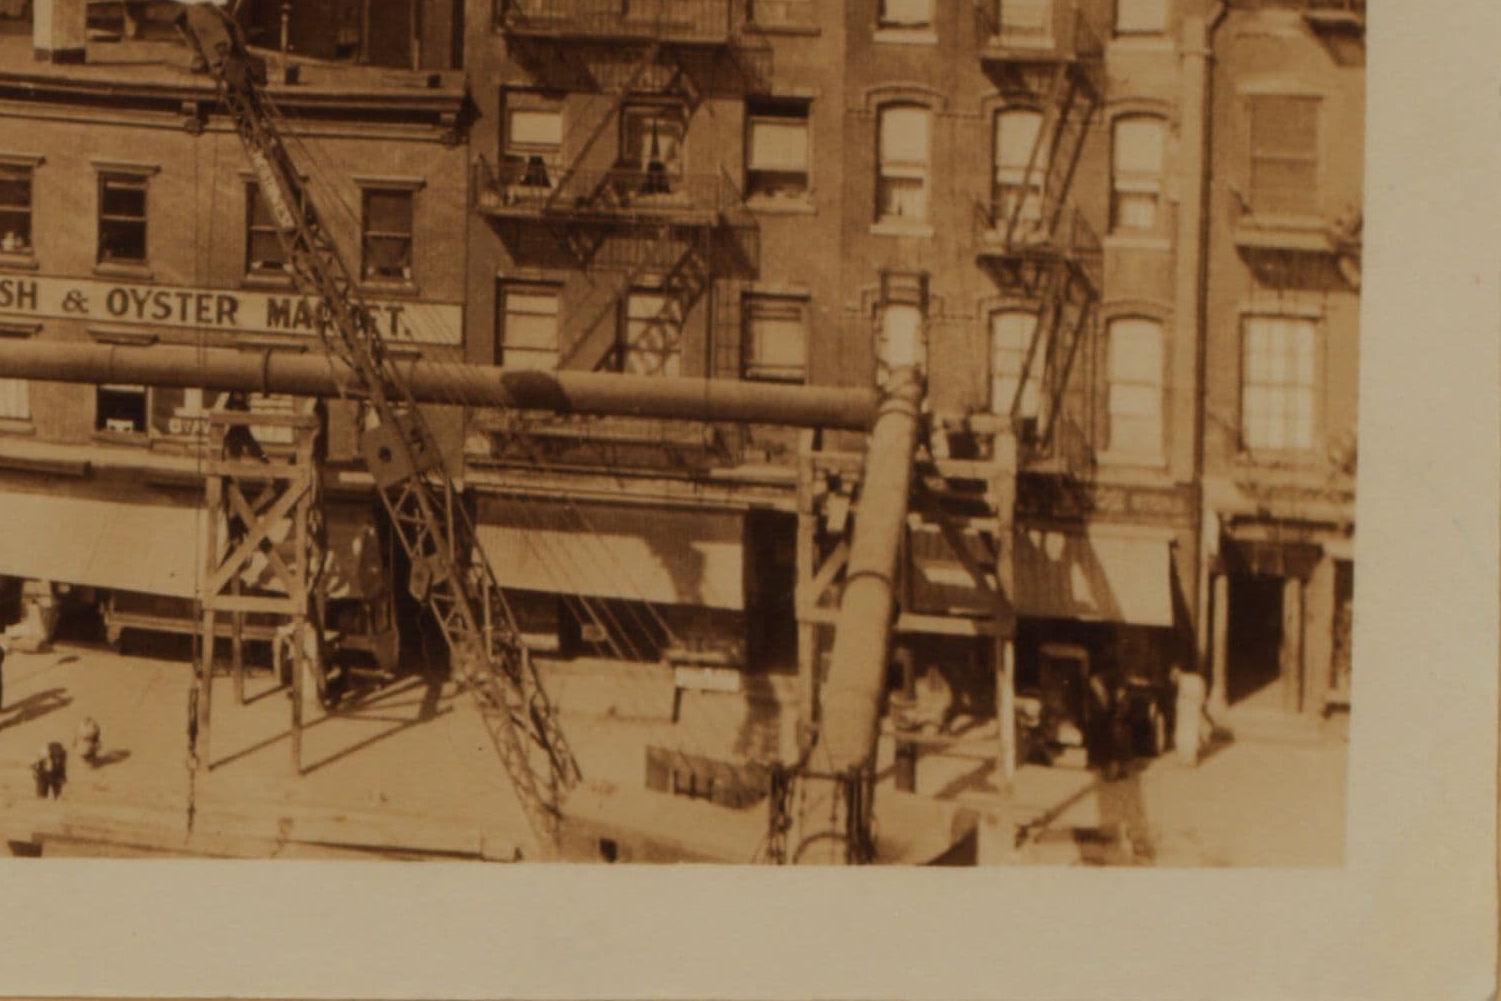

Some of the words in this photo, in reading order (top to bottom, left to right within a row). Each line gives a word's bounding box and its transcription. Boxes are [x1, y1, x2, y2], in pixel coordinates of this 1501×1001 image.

[61, 289, 90, 314] &
[105, 287, 240, 326] OYSTER
[266, 297, 412, 337] MART.
